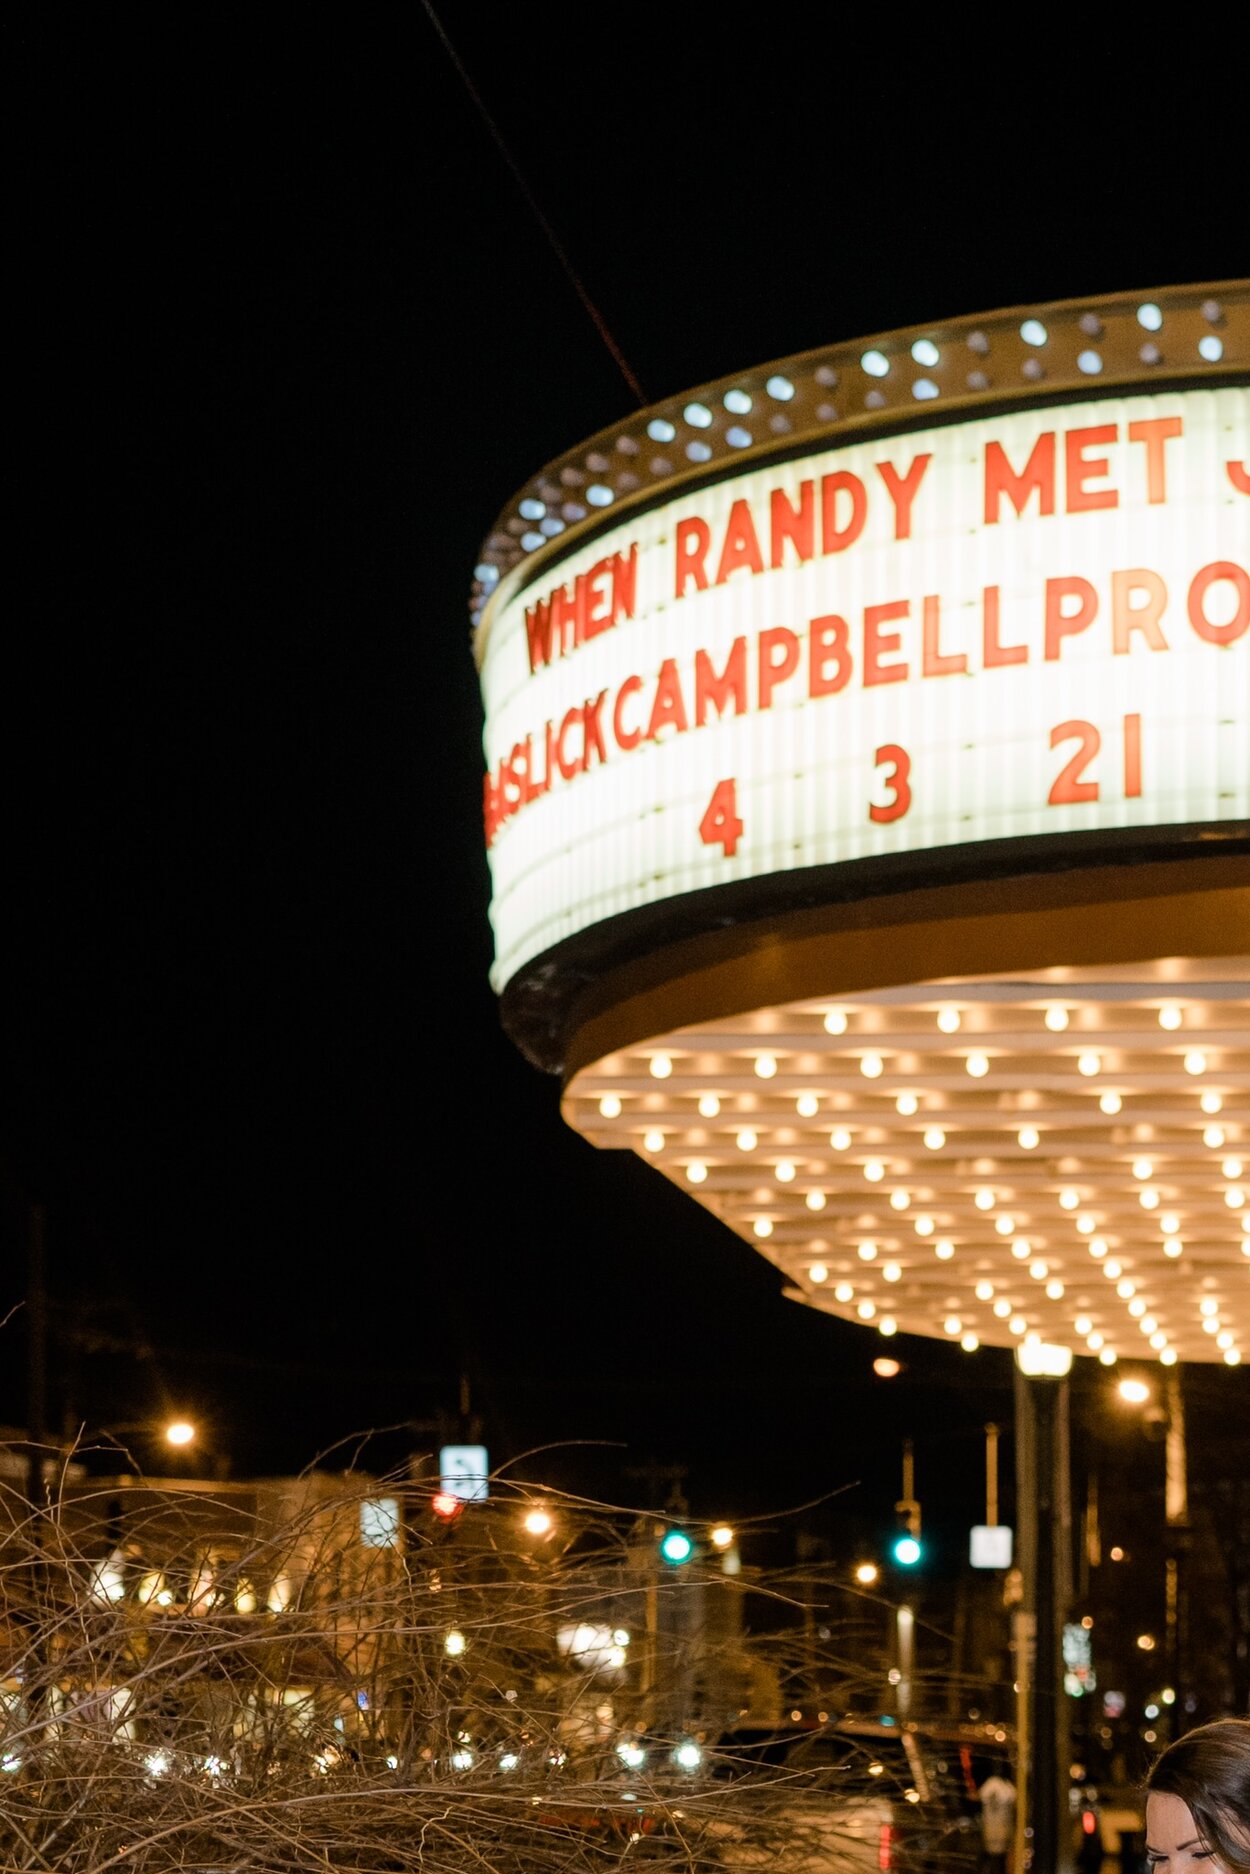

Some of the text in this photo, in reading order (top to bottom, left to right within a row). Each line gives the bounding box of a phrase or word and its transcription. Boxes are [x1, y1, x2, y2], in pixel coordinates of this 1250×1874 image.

[524, 541, 639, 674] WHEN
[673, 452, 933, 600] RANDY
[982, 415, 1187, 526] MET
[697, 713, 1143, 859] 4 3 21
